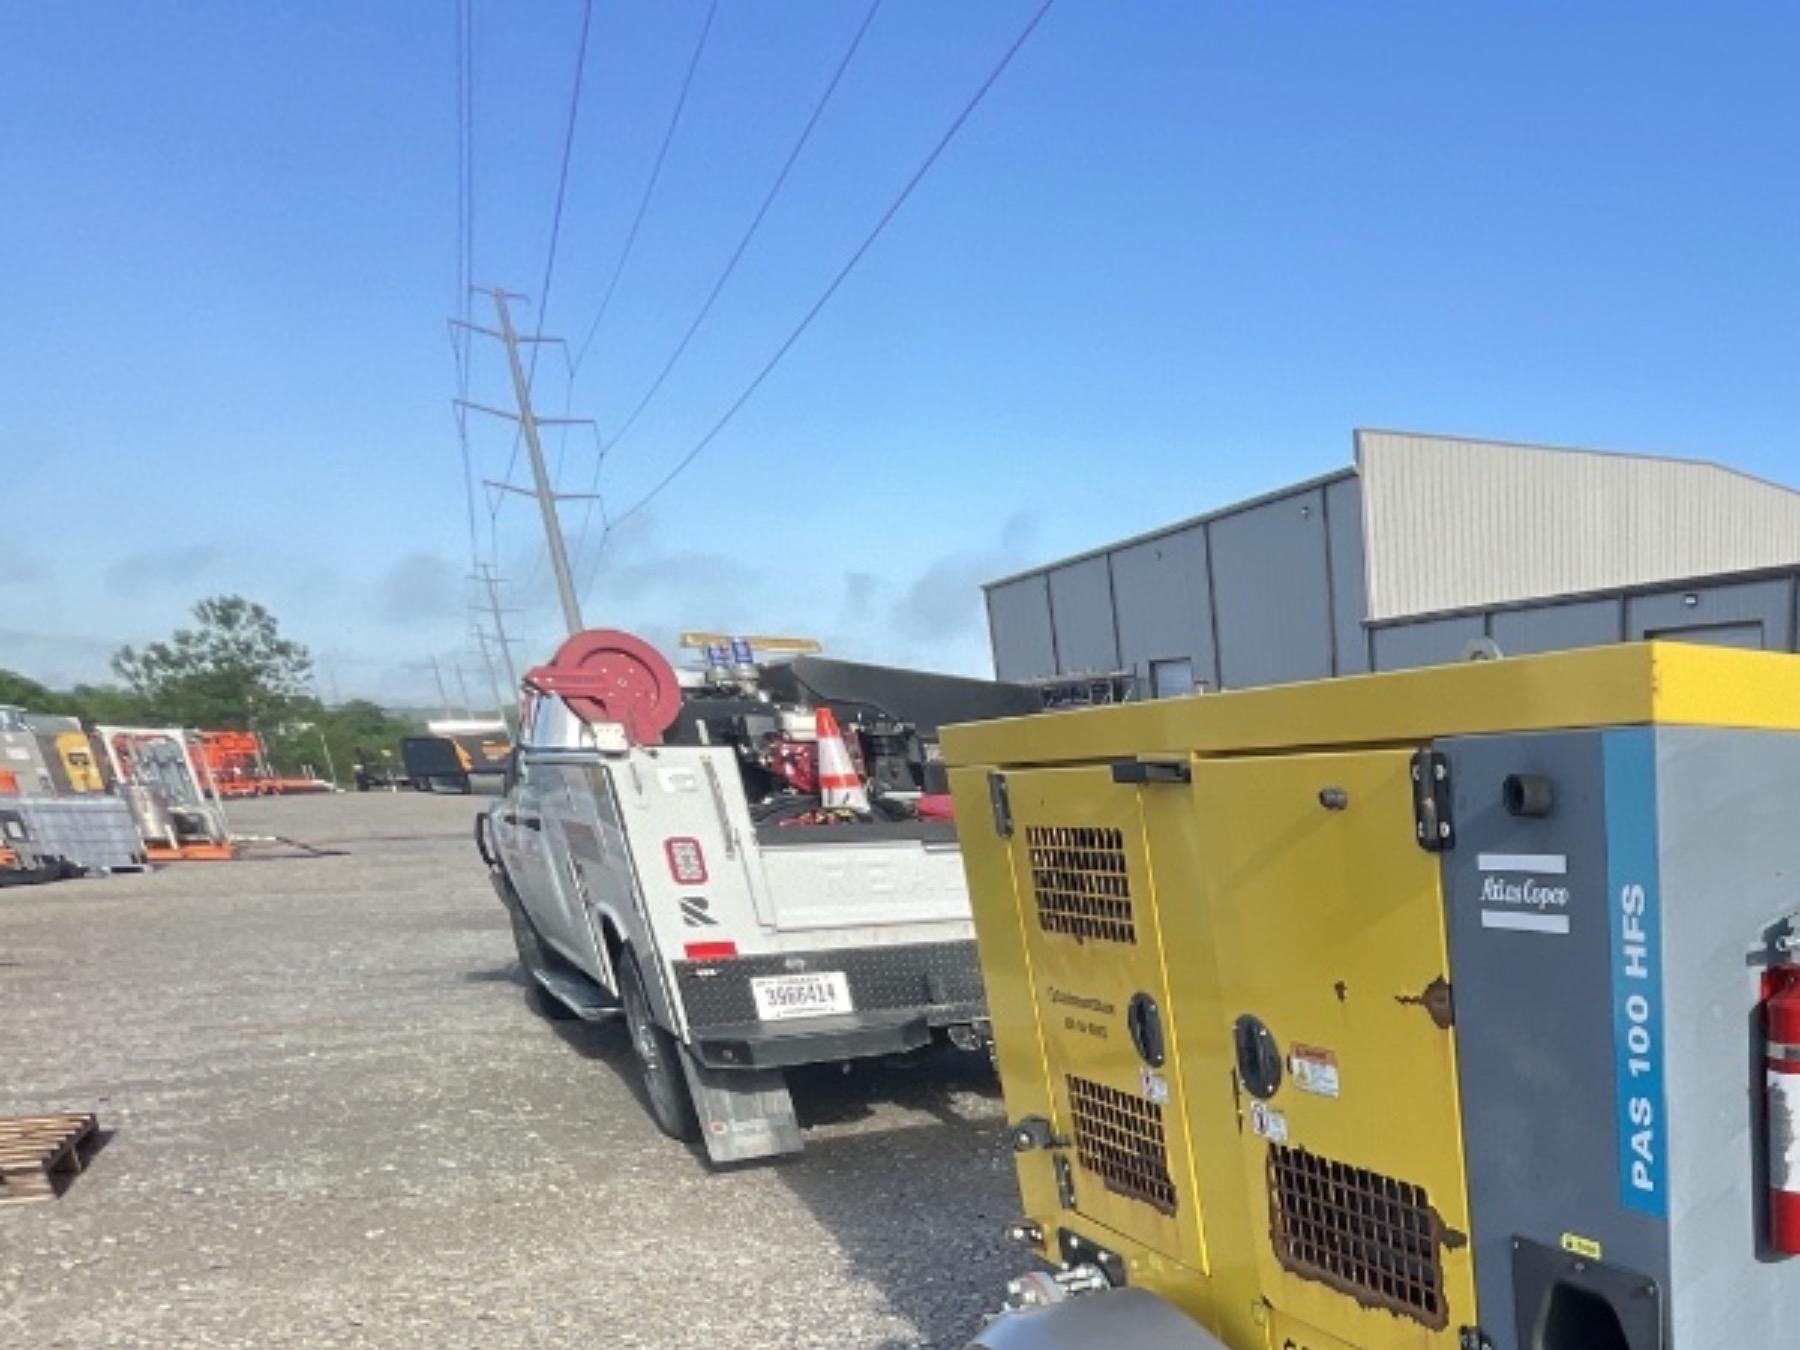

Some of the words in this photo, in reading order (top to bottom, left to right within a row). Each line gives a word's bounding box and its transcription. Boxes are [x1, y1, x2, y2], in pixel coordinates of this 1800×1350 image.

[1621, 883, 1649, 979] HFS
[1625, 994, 1652, 1078] 100
[1628, 1096, 1655, 1194] PAS
